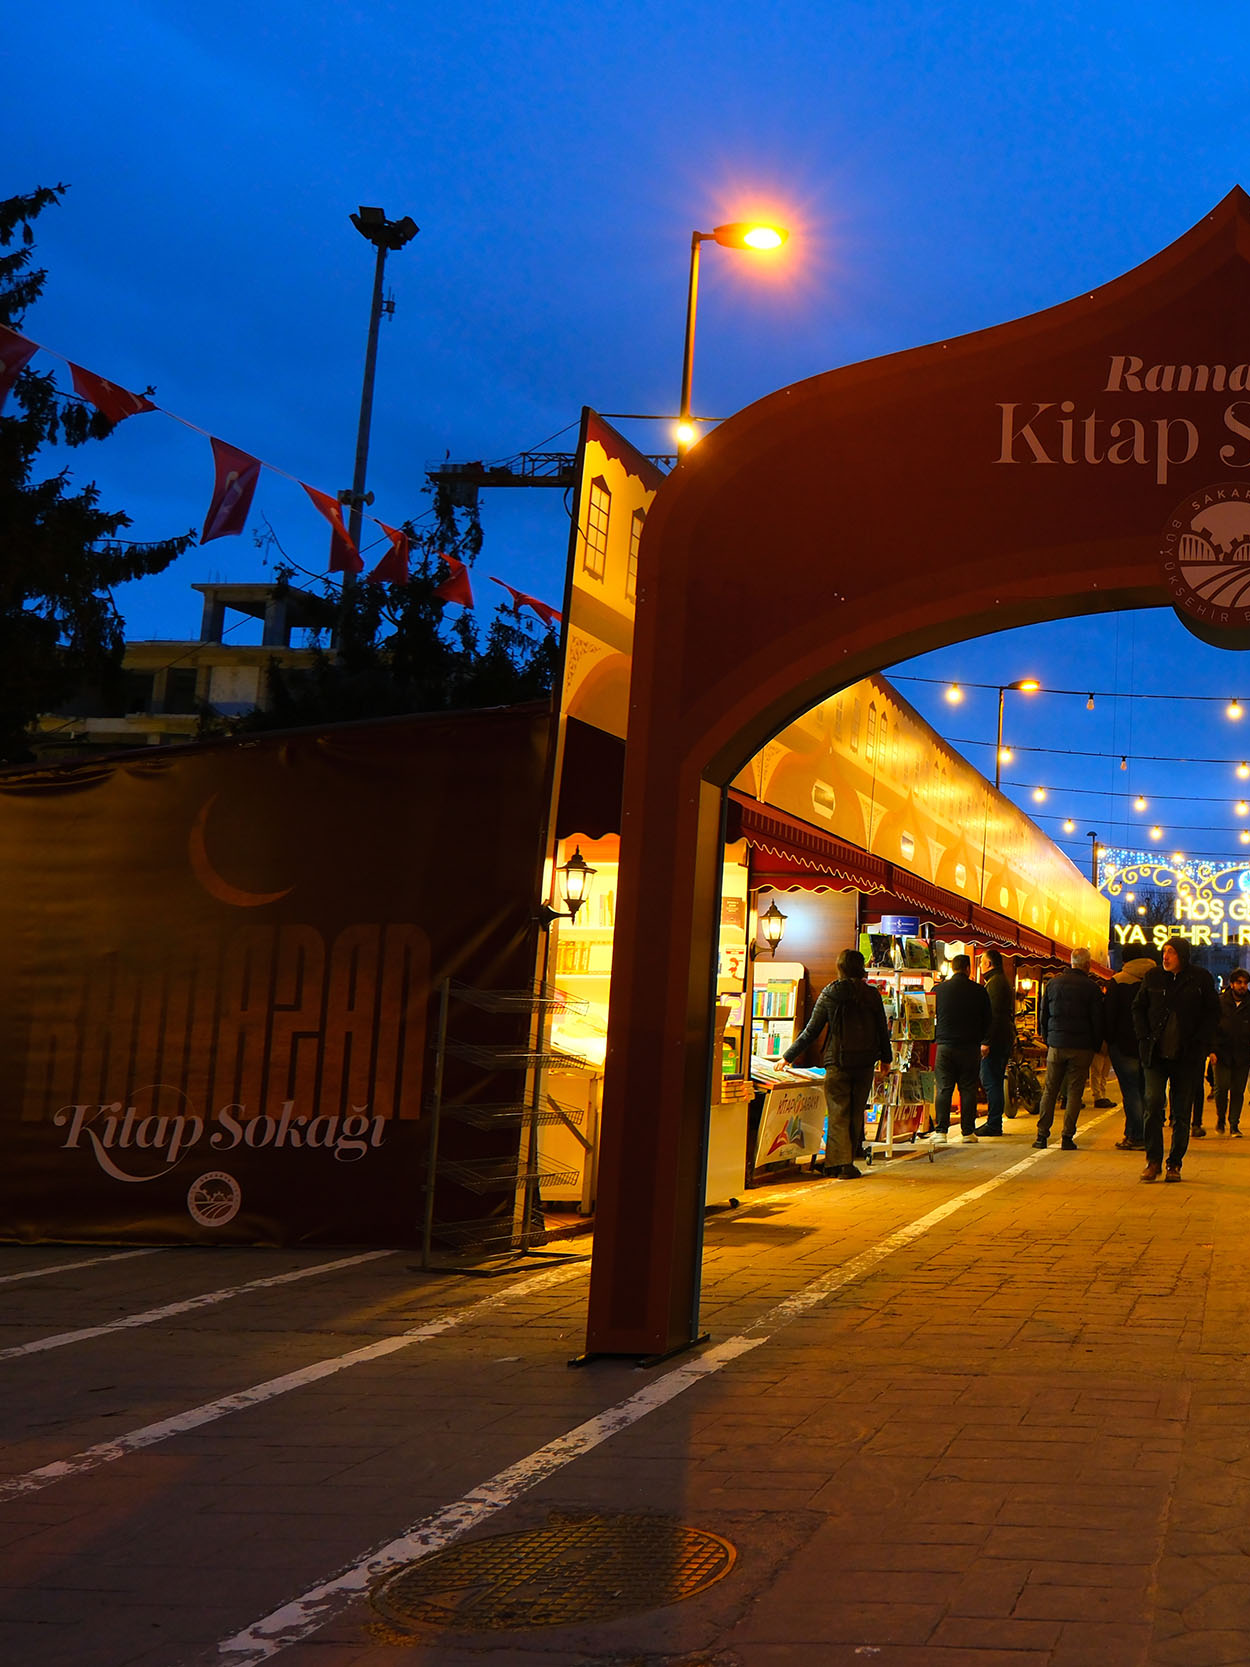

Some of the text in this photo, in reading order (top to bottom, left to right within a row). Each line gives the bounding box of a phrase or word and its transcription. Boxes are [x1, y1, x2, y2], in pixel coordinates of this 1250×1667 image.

[992, 401, 1199, 484] Kitap
[1114, 923, 1147, 946] YA
[1175, 898, 1225, 924] HOŞ
[53, 1083, 387, 1182] Kitap Sokağı
